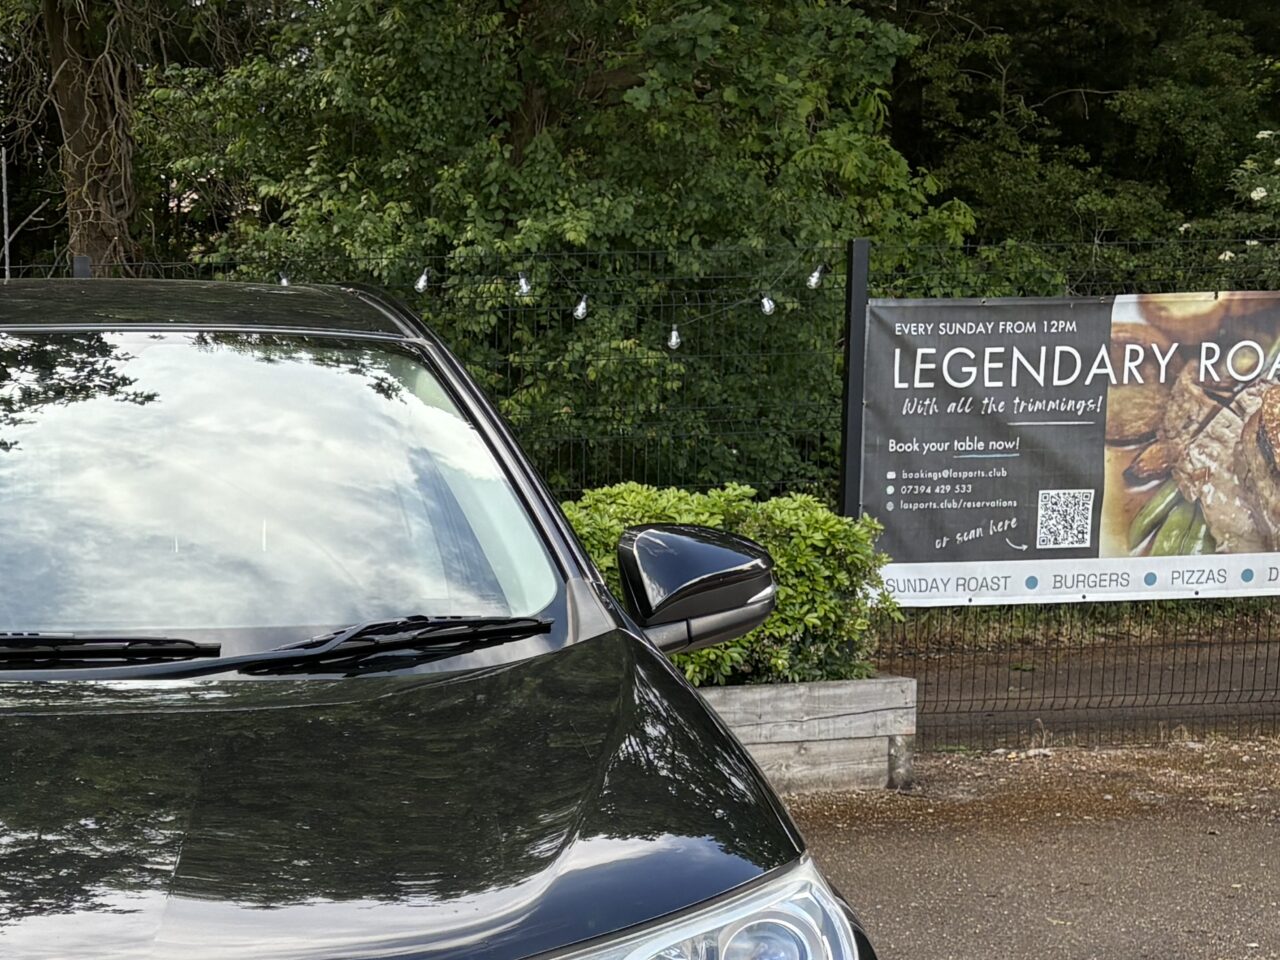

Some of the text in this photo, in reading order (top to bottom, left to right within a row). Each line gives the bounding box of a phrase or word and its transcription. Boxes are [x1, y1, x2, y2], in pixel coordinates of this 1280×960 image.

[895, 320, 1077, 335] EVERY SUNDAY FROM 12PM
[893, 342, 1179, 389] LEGENDARY
[902, 395, 1103, 415] With all the trimmings!
[888, 436, 1020, 455] Book your table now!
[900, 484, 972, 494] 07394 429 533
[935, 517, 1018, 549] or scan here
[885, 577, 951, 593] SUNDAY
[955, 575, 1012, 592] ROAST
[1052, 572, 1131, 590] BURGERS
[1170, 569, 1227, 585] PIZZAS
